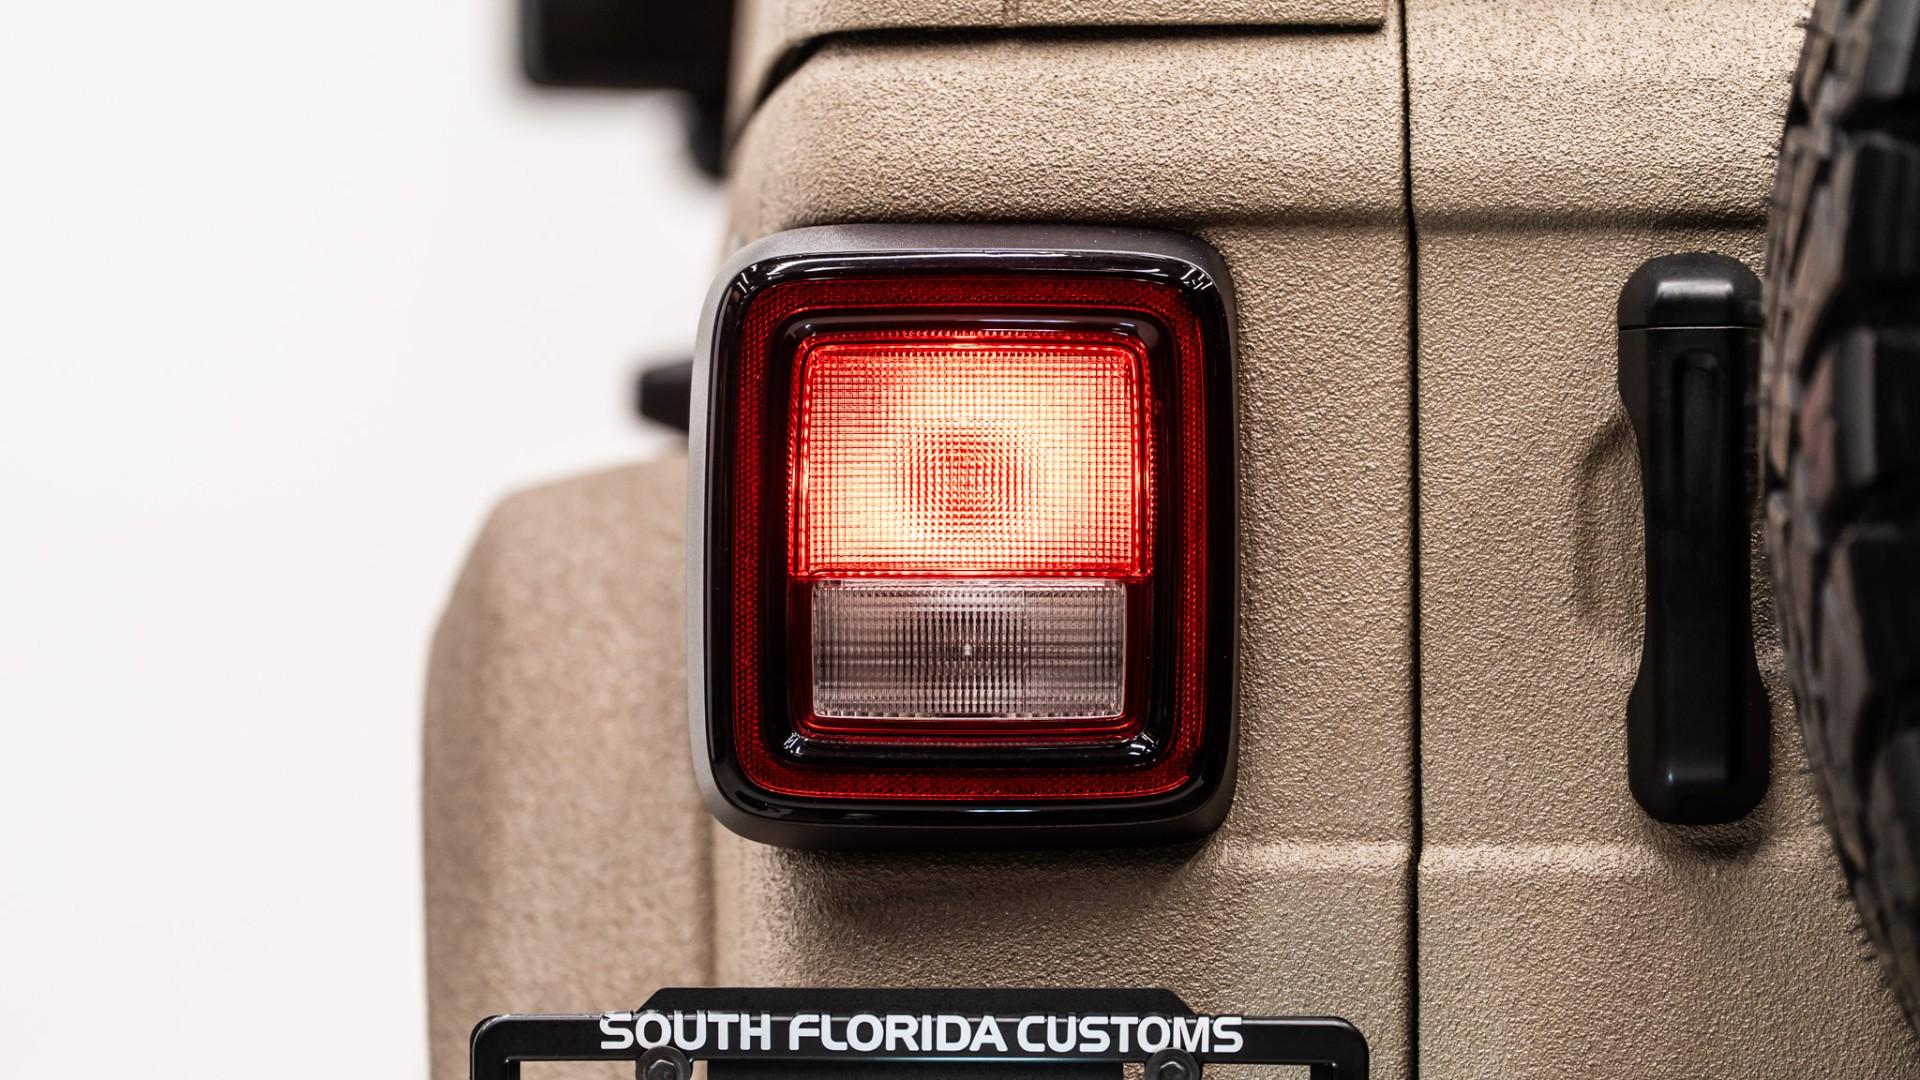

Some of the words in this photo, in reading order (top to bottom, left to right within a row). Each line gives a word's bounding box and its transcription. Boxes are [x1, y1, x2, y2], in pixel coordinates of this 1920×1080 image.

[599, 1011, 772, 1051] SOUTH
[788, 1014, 1009, 1052] FLORIDA
[1017, 1015, 1244, 1053] CUSTOMS
